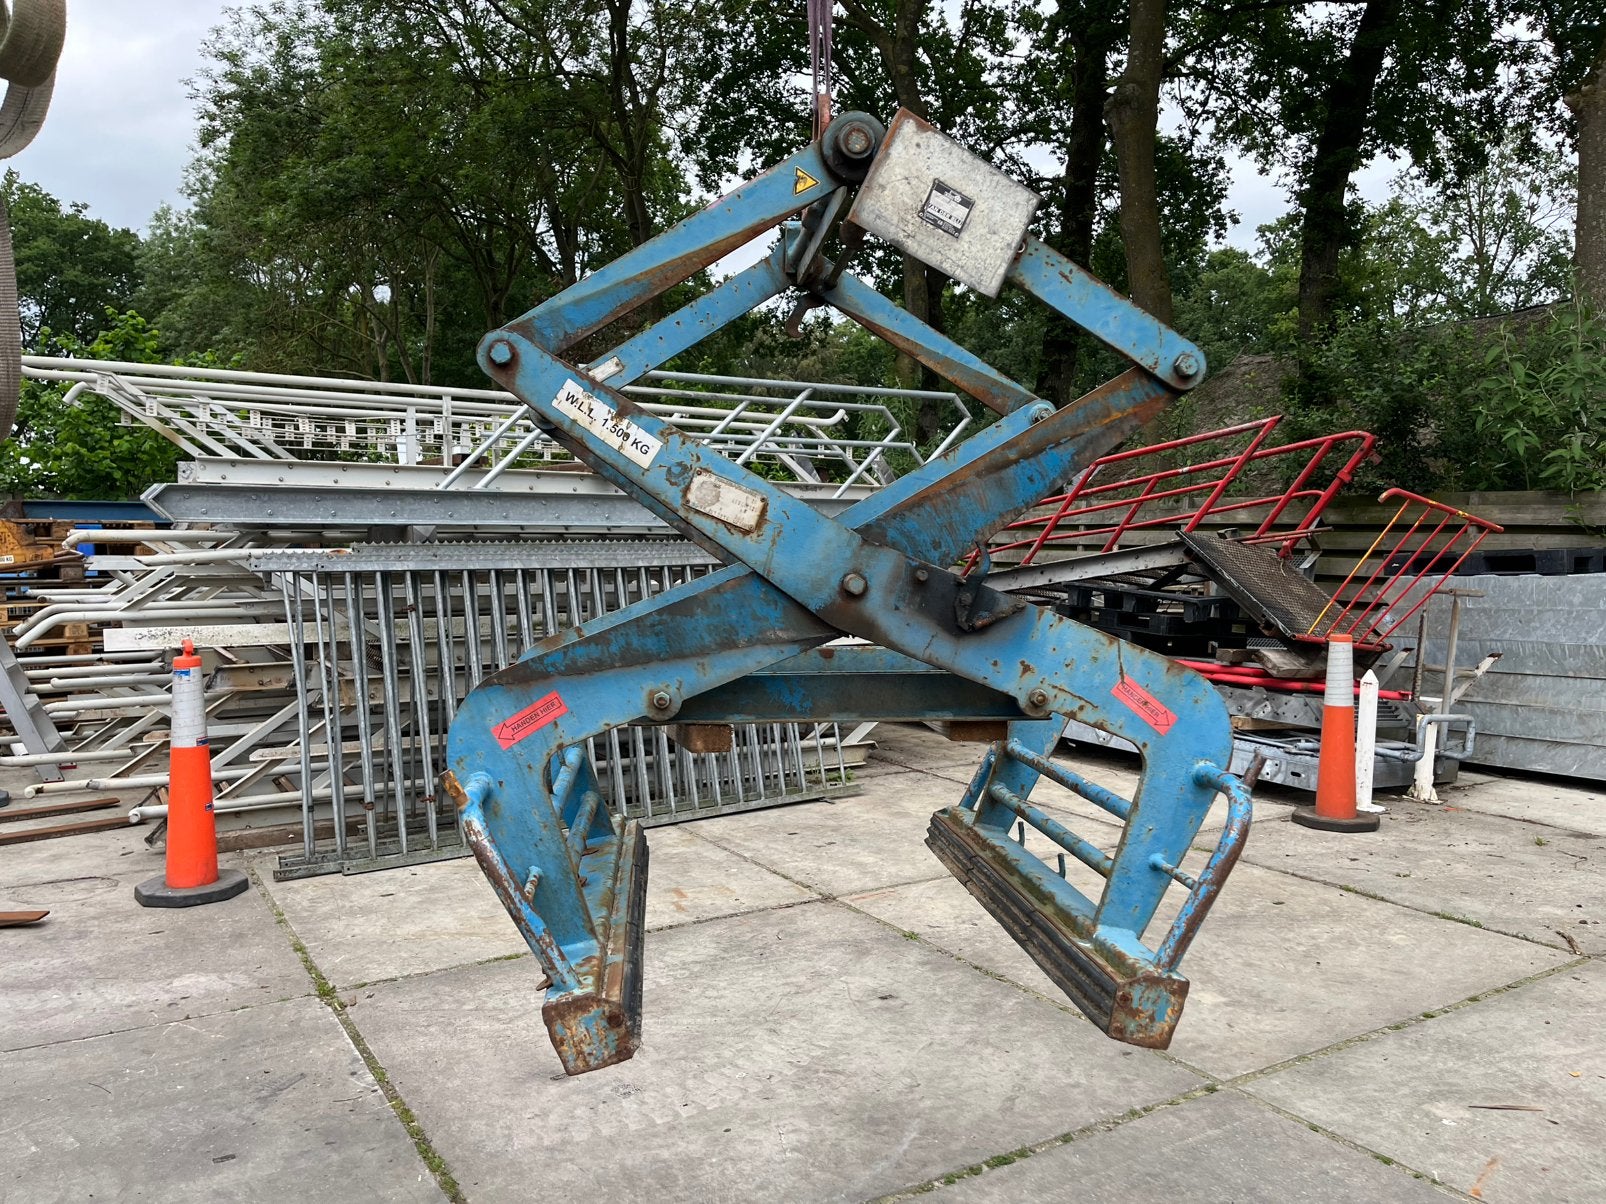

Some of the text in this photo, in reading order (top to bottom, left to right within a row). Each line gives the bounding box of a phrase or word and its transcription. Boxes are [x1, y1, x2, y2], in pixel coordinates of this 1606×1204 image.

[565, 391, 650, 456] W.L.L. 1.500 KG
[511, 701, 556, 733] HANDEN HIER
